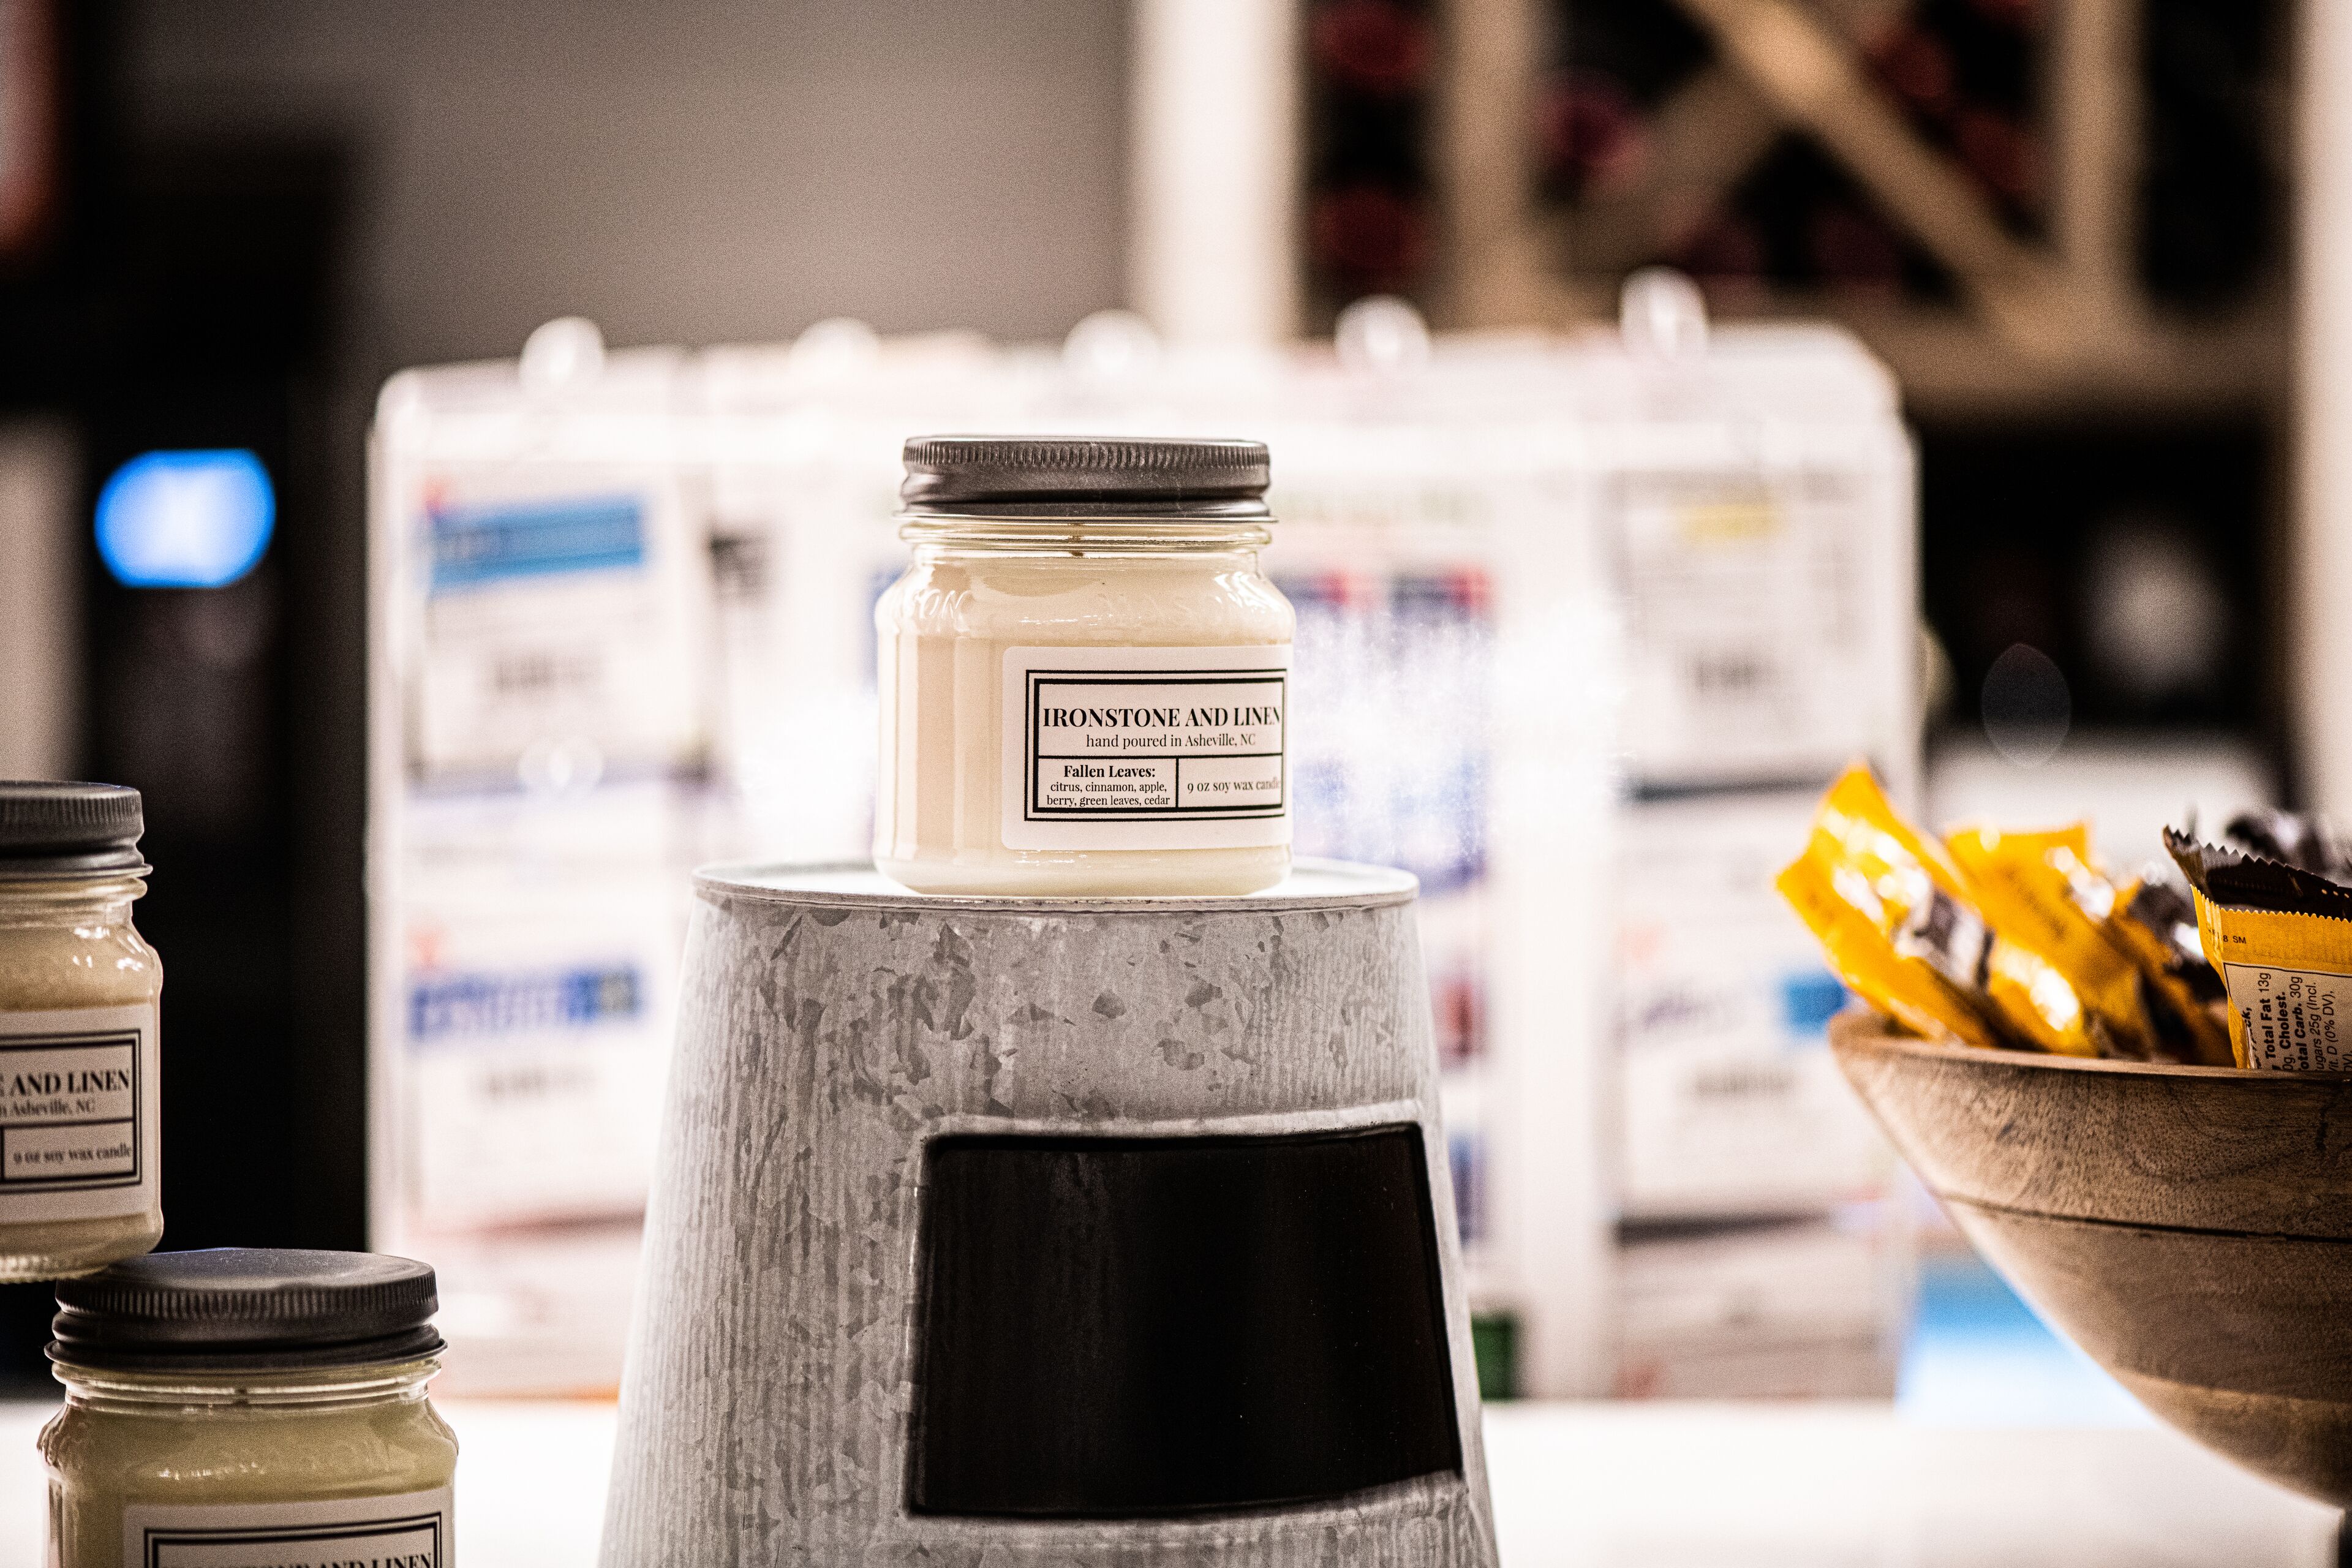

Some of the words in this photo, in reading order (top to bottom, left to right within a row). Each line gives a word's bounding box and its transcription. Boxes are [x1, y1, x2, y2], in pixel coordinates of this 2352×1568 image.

[1042, 708, 1180, 728] IRONSTONE
[1185, 707, 1229, 728] AND
[1086, 734, 1119, 747] hand
[1123, 734, 1167, 750] poured
[1170, 734, 1182, 747] in
[1185, 733, 1237, 748] Asheville,
[1240, 733, 1256, 746] NC
[1063, 764, 1105, 778] Fallen
[1109, 765, 1156, 778] Leaves:
[1050, 782, 1083, 793] citrus,
[1085, 782, 1137, 793] cinnamon,
[1139, 781, 1167, 794] apple,
[1187, 783, 1194, 794] 9
[1197, 782, 1210, 792] oz
[1213, 782, 1231, 794] soy
[1234, 781, 1254, 791] wax
[1046, 794, 1077, 807] berry,
[1079, 796, 1108, 807] green
[1110, 795, 1142, 807] leaves,
[1144, 794, 1170, 805] cedar
[2233, 935, 2247, 944] SM
[2258, 973, 2272, 993] 13g
[2289, 976, 2303, 999] 30g
[2305, 982, 2320, 1011] (Incl.
[2321, 990, 2336, 1016] DV),
[2260, 998, 2272, 1021] Fat
[2275, 991, 2291, 1050] Cholest.
[2292, 1003, 2306, 1039] Carb.
[2309, 1014, 2322, 1036] 25g
[2324, 1019, 2339, 1042] (0%
[2261, 1025, 2277, 1060] Total
[2327, 1046, 2338, 1055] D
[2295, 1042, 2309, 1071] otal
[2313, 1038, 2326, 1071] ugars
[9, 1072, 61, 1096] AND
[67, 1069, 130, 1093] LINEN
[75, 1098, 96, 1114] NC
[67, 1148, 93, 1160] wax
